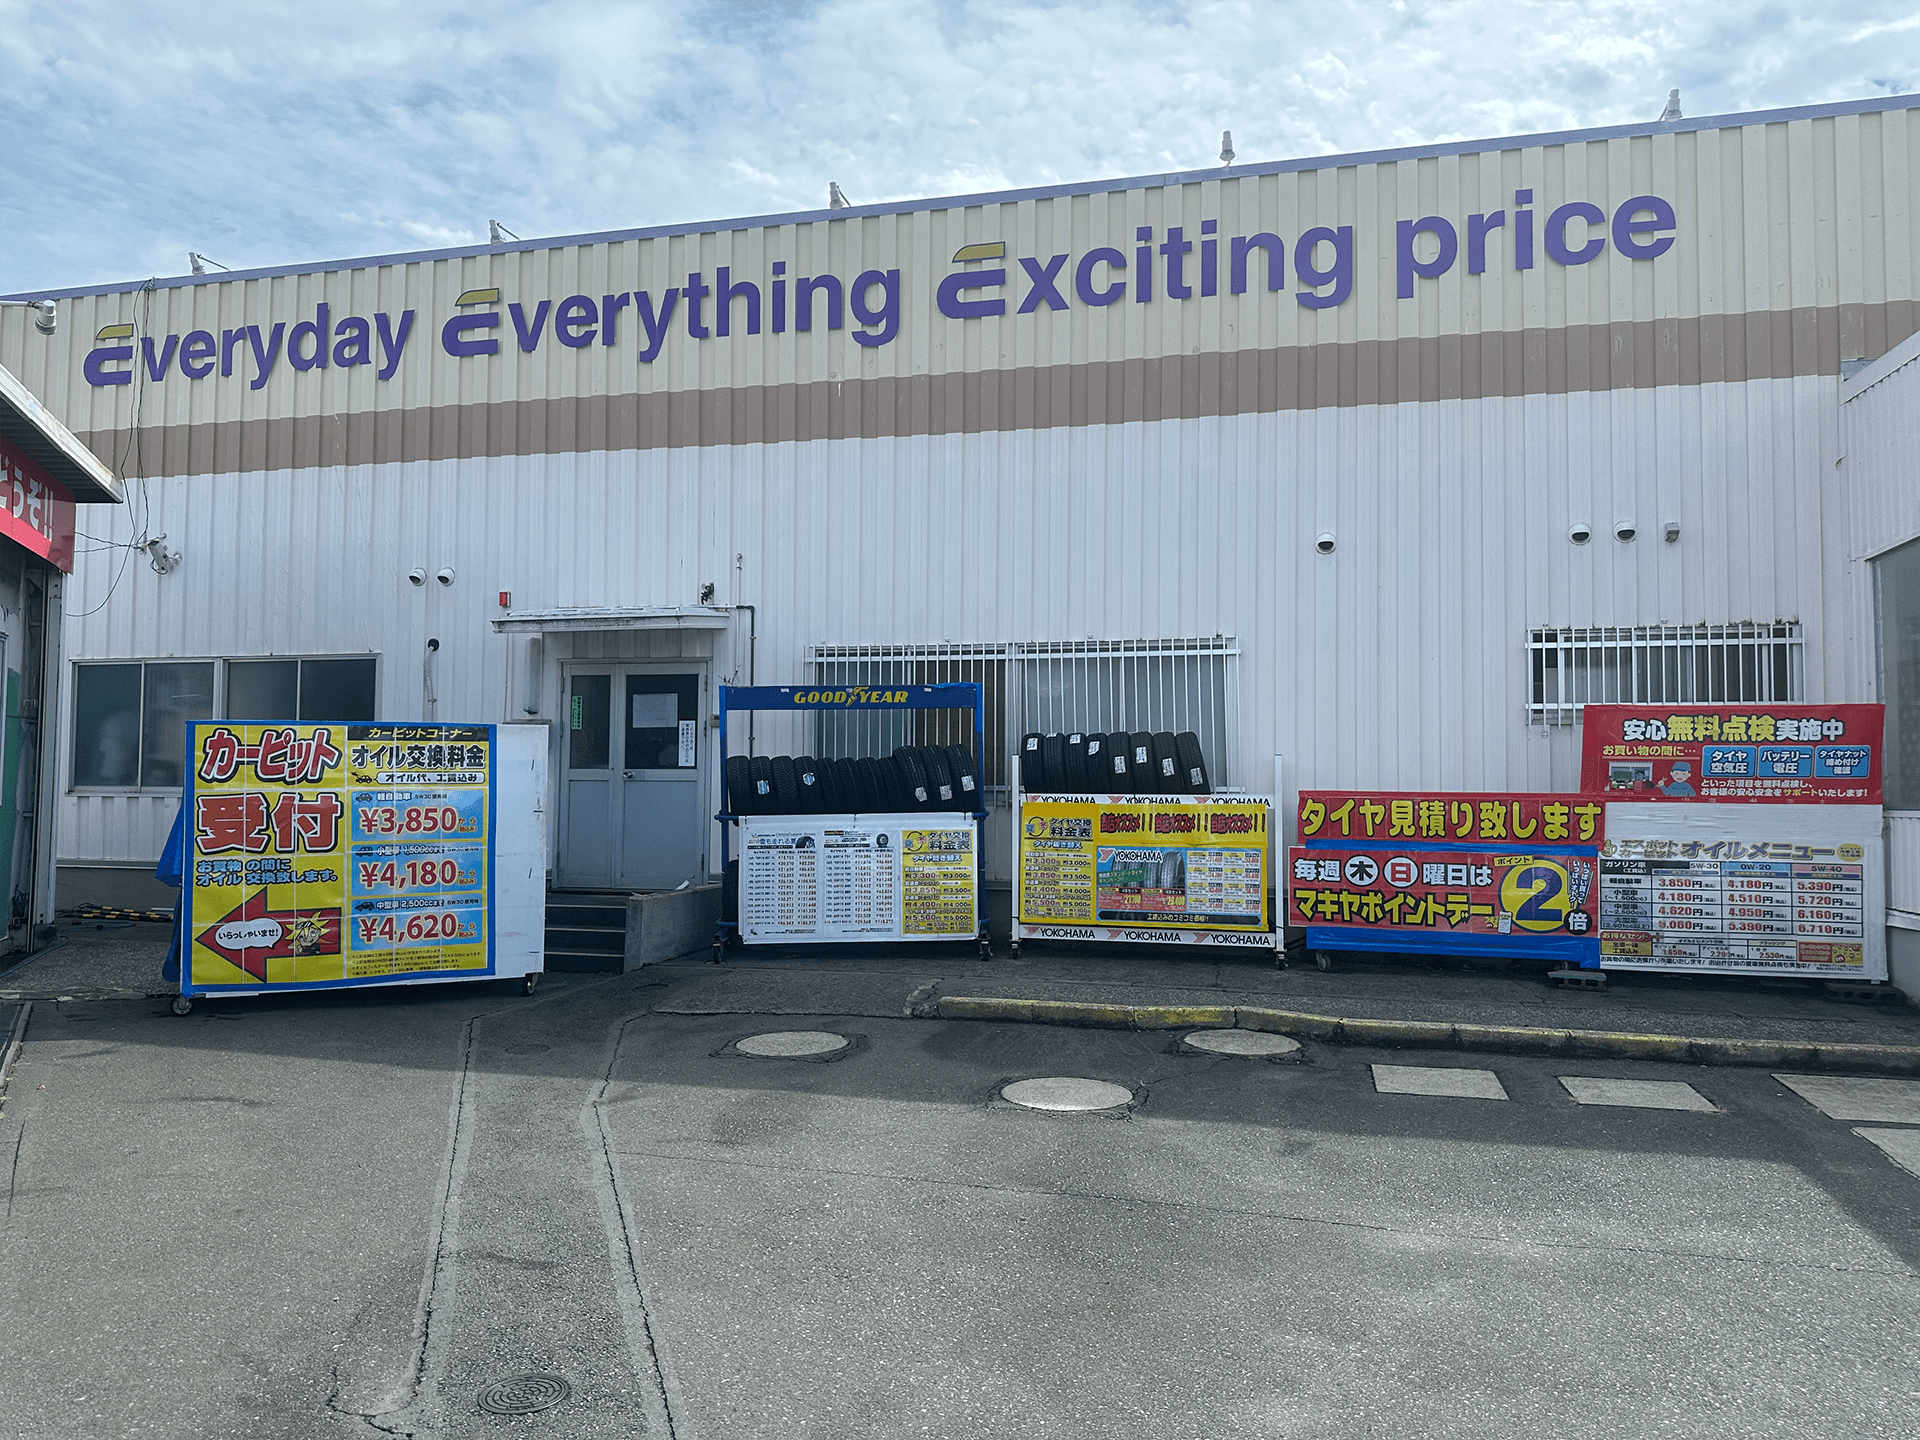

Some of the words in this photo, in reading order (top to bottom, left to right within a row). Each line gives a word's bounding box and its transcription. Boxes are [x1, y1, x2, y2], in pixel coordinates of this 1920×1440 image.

[84, 302, 415, 390] Everyday
[442, 261, 900, 362] Everything
[937, 220, 1352, 319] Exciting
[1397, 189, 1676, 298] price
[1623, 715, 1844, 742] 安心無料点検実施中
[198, 728, 342, 785] カーピット
[350, 743, 486, 770] オイル交換料金
[1710, 762, 1749, 774] 空気圧
[1772, 763, 1799, 774] 電圧
[1711, 750, 1748, 762] タイヤ
[1761, 751, 1811, 762] バッテリー
[1818, 750, 1867, 758] タイヤナット
[195, 792, 343, 854] 受付
[359, 806, 458, 836] ¥3,850
[1301, 798, 1602, 840] タイヤ見積り致します
[1114, 850, 1163, 862] YOKOHAMA
[1497, 856, 1530, 865] ポイント
[1680, 840, 1835, 860] オイルメニュー
[359, 859, 458, 891] ¥4,180
[1516, 867, 1562, 922] 2
[1294, 888, 1494, 929] マキヤポイントデー
[1568, 912, 1588, 931] 倍
[359, 912, 458, 944] ¥4,620
[1040, 927, 1096, 938] YOKOHAMA
[1124, 930, 1182, 942] YOKOHAMA
[1211, 934, 1271, 946] YOKOHAMA
